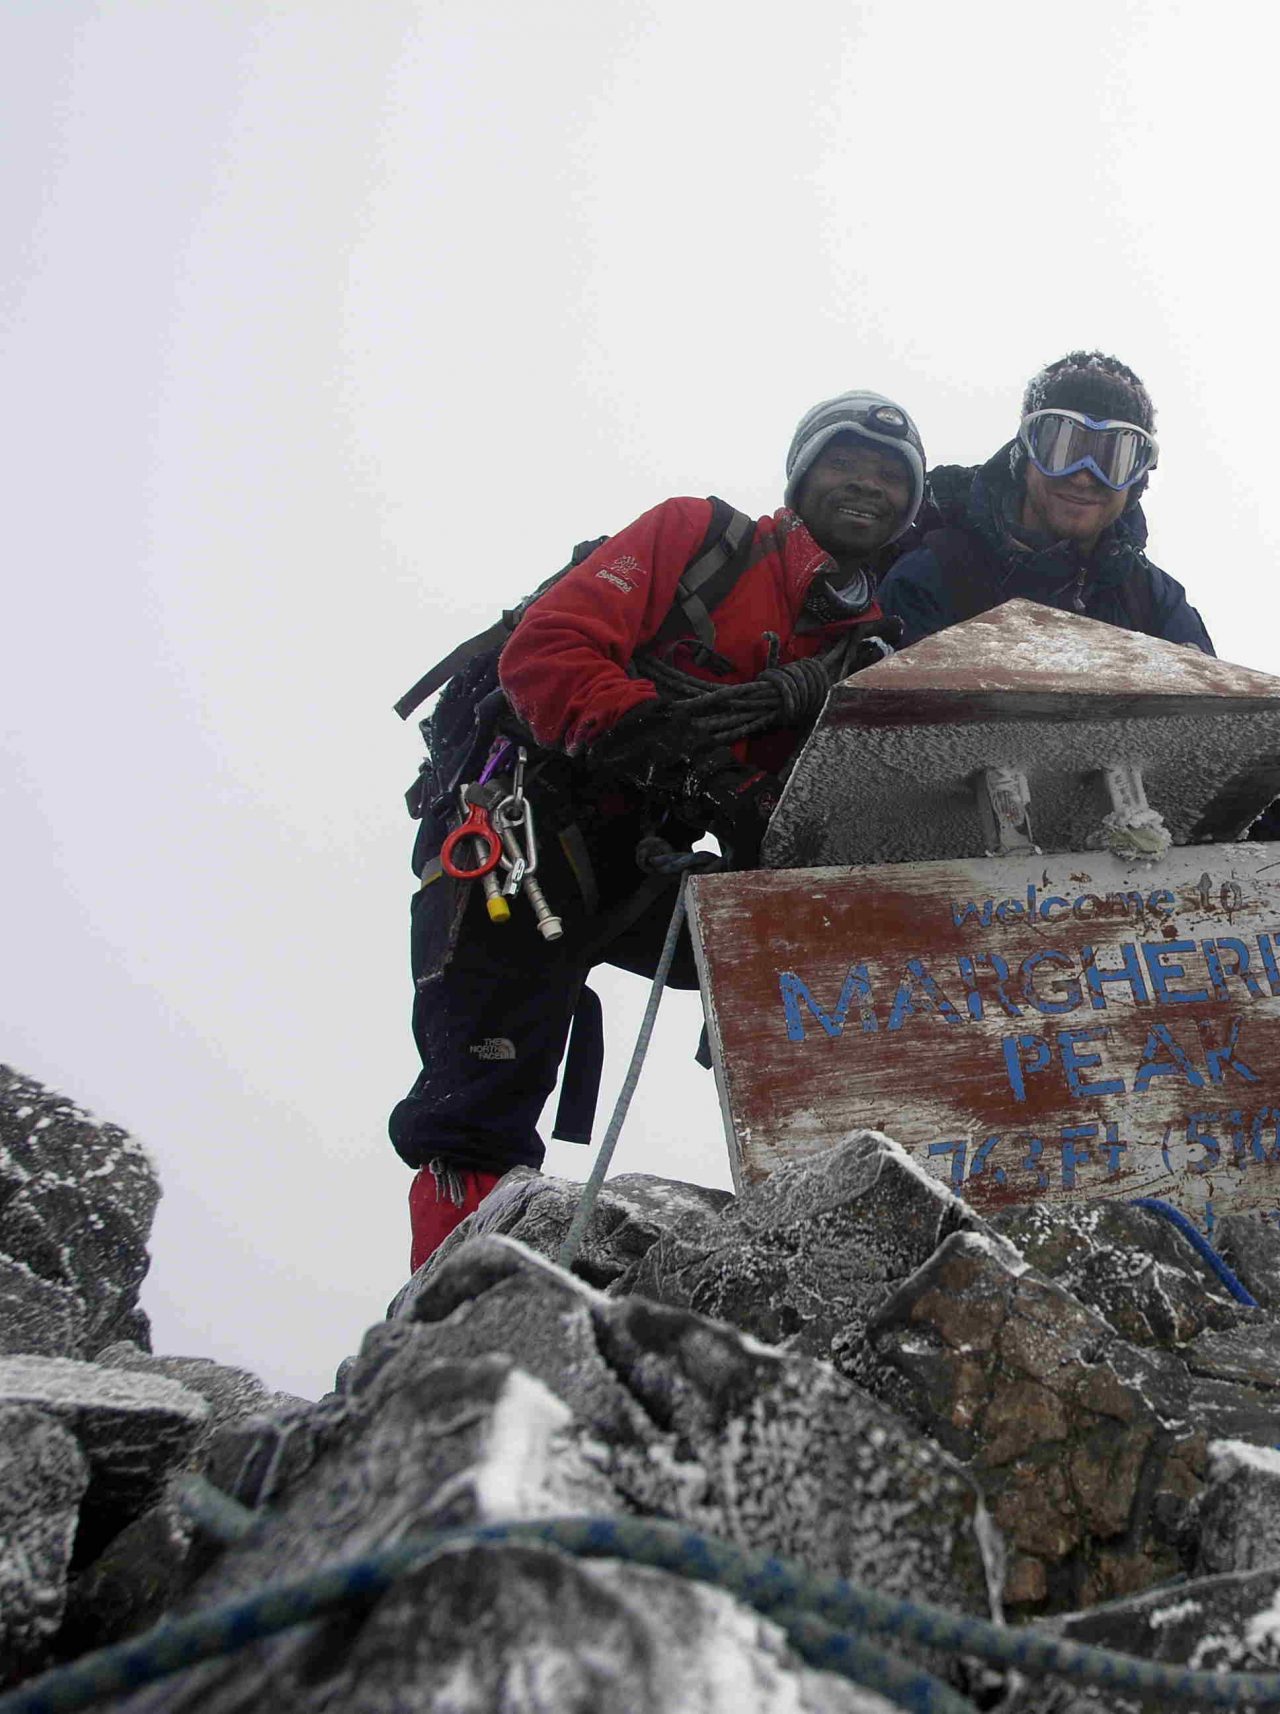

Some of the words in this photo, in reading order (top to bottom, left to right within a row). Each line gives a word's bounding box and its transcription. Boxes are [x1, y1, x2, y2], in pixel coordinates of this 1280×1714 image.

[951, 883, 1176, 928] welcome
[1199, 871, 1243, 913] to
[470, 1045, 501, 1053] NORTH
[1002, 1014, 1261, 1102] PEAK
